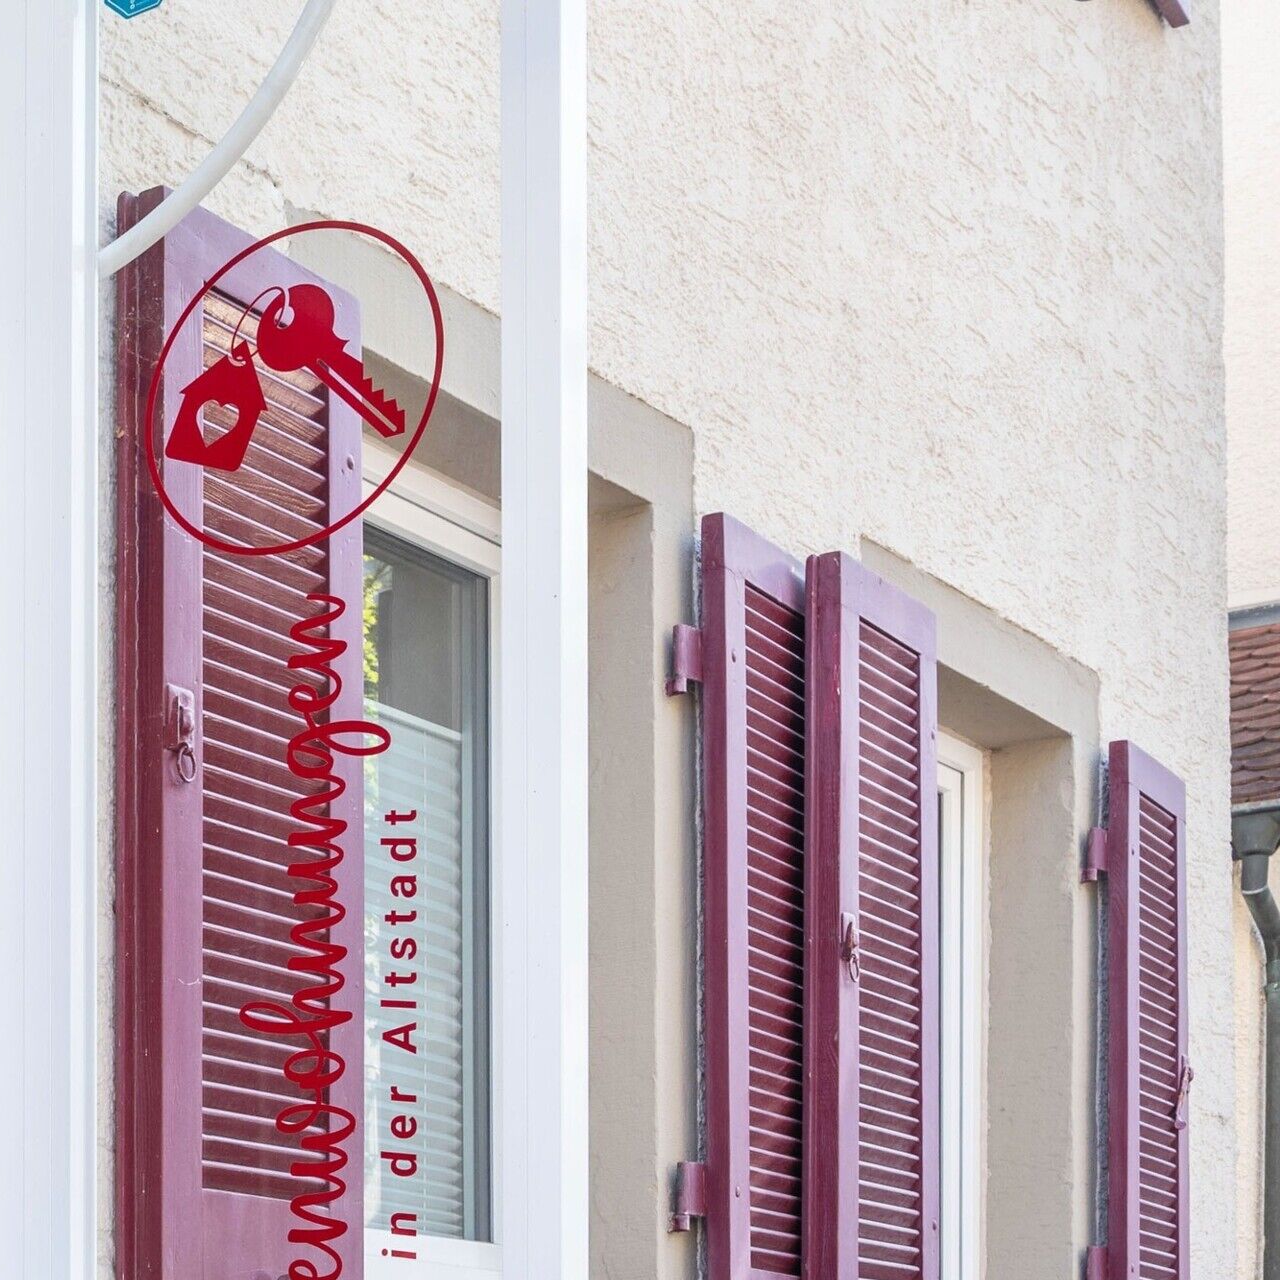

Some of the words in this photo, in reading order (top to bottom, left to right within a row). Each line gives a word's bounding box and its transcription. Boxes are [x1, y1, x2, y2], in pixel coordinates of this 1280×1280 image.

[381, 811, 417, 1053] Altstadt
[381, 1087, 417, 1177] der
[381, 1211, 417, 1260] in
